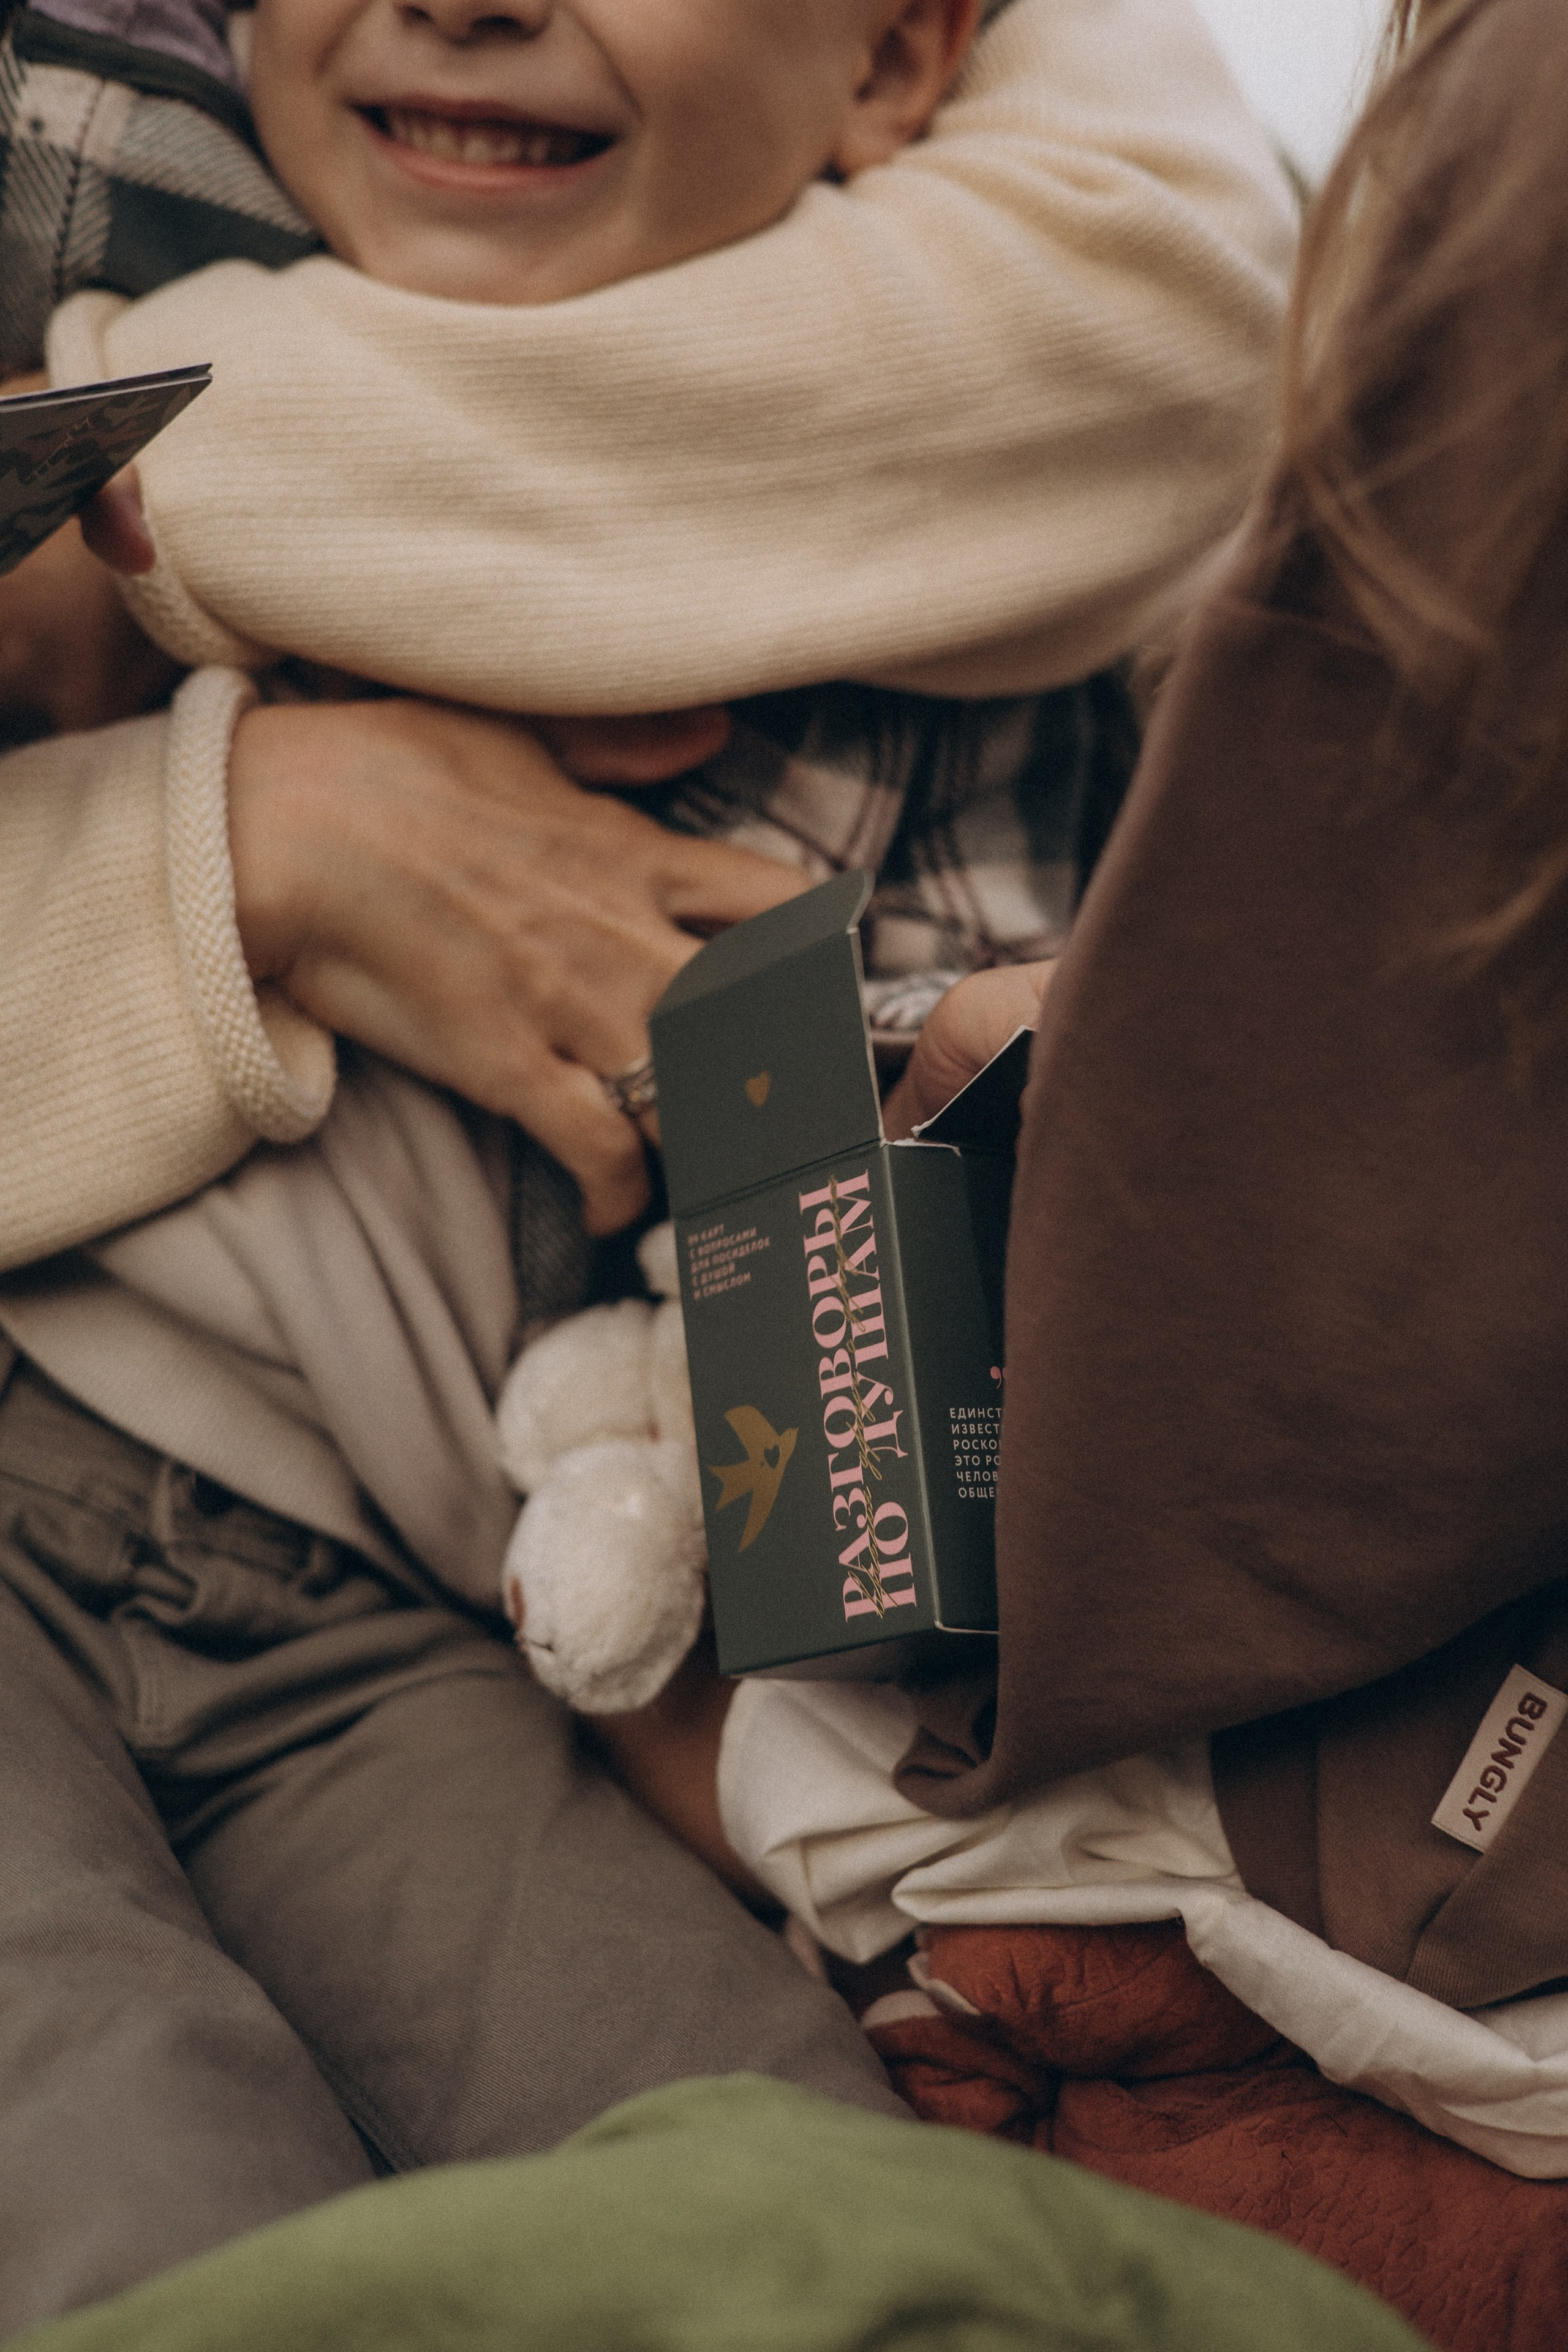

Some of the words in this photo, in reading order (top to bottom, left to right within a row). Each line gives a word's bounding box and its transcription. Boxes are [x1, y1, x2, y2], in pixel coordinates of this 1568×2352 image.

[689, 1248, 695, 1260] С
[698, 1226, 757, 1256] ВОПРОСАМИ
[701, 1223, 724, 1241] КАРТ
[691, 1257, 710, 1274] ДЛЯ
[712, 1236, 770, 1265] ПОСИДЕЛОК
[692, 1275, 698, 1287] С
[701, 1261, 735, 1285] ДУШОЙ
[703, 1271, 752, 1297] СМЫСЛОМ
[834, 1169, 908, 1459] ДУШАМ
[799, 1181, 879, 1623] РАЗГОВОРЫ
[949, 1408, 1002, 1420] ЕДИНСТ
[951, 1423, 1000, 1434] ИЗВЕСТ
[953, 1439, 1001, 1450] РОСКО
[955, 1455, 980, 1466] ЭТО
[958, 1487, 998, 1499] ОБЩЕ
[873, 1501, 918, 1610] ПО
[1463, 1692, 1548, 1831] BUNGLY
